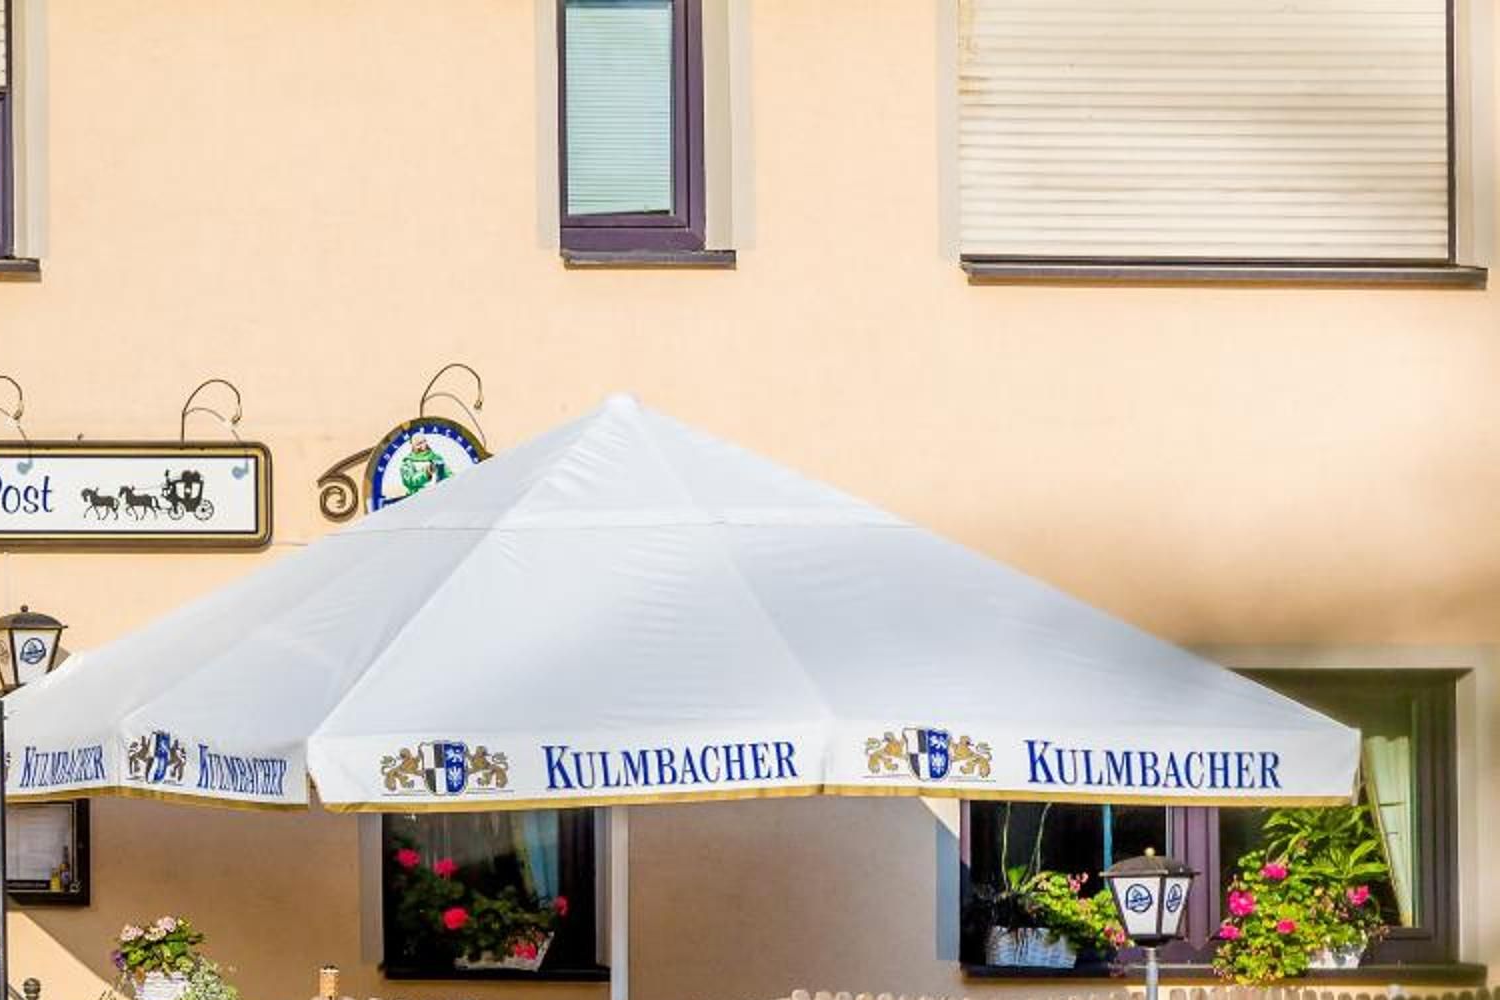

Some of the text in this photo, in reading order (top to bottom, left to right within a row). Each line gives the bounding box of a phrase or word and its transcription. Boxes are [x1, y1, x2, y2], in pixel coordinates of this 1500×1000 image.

[19, 745, 106, 788] KULMBACHER
[197, 744, 288, 796] KULMBACHER
[541, 740, 800, 790] KULMBACHER
[1025, 739, 1283, 790] KULMBACHER
